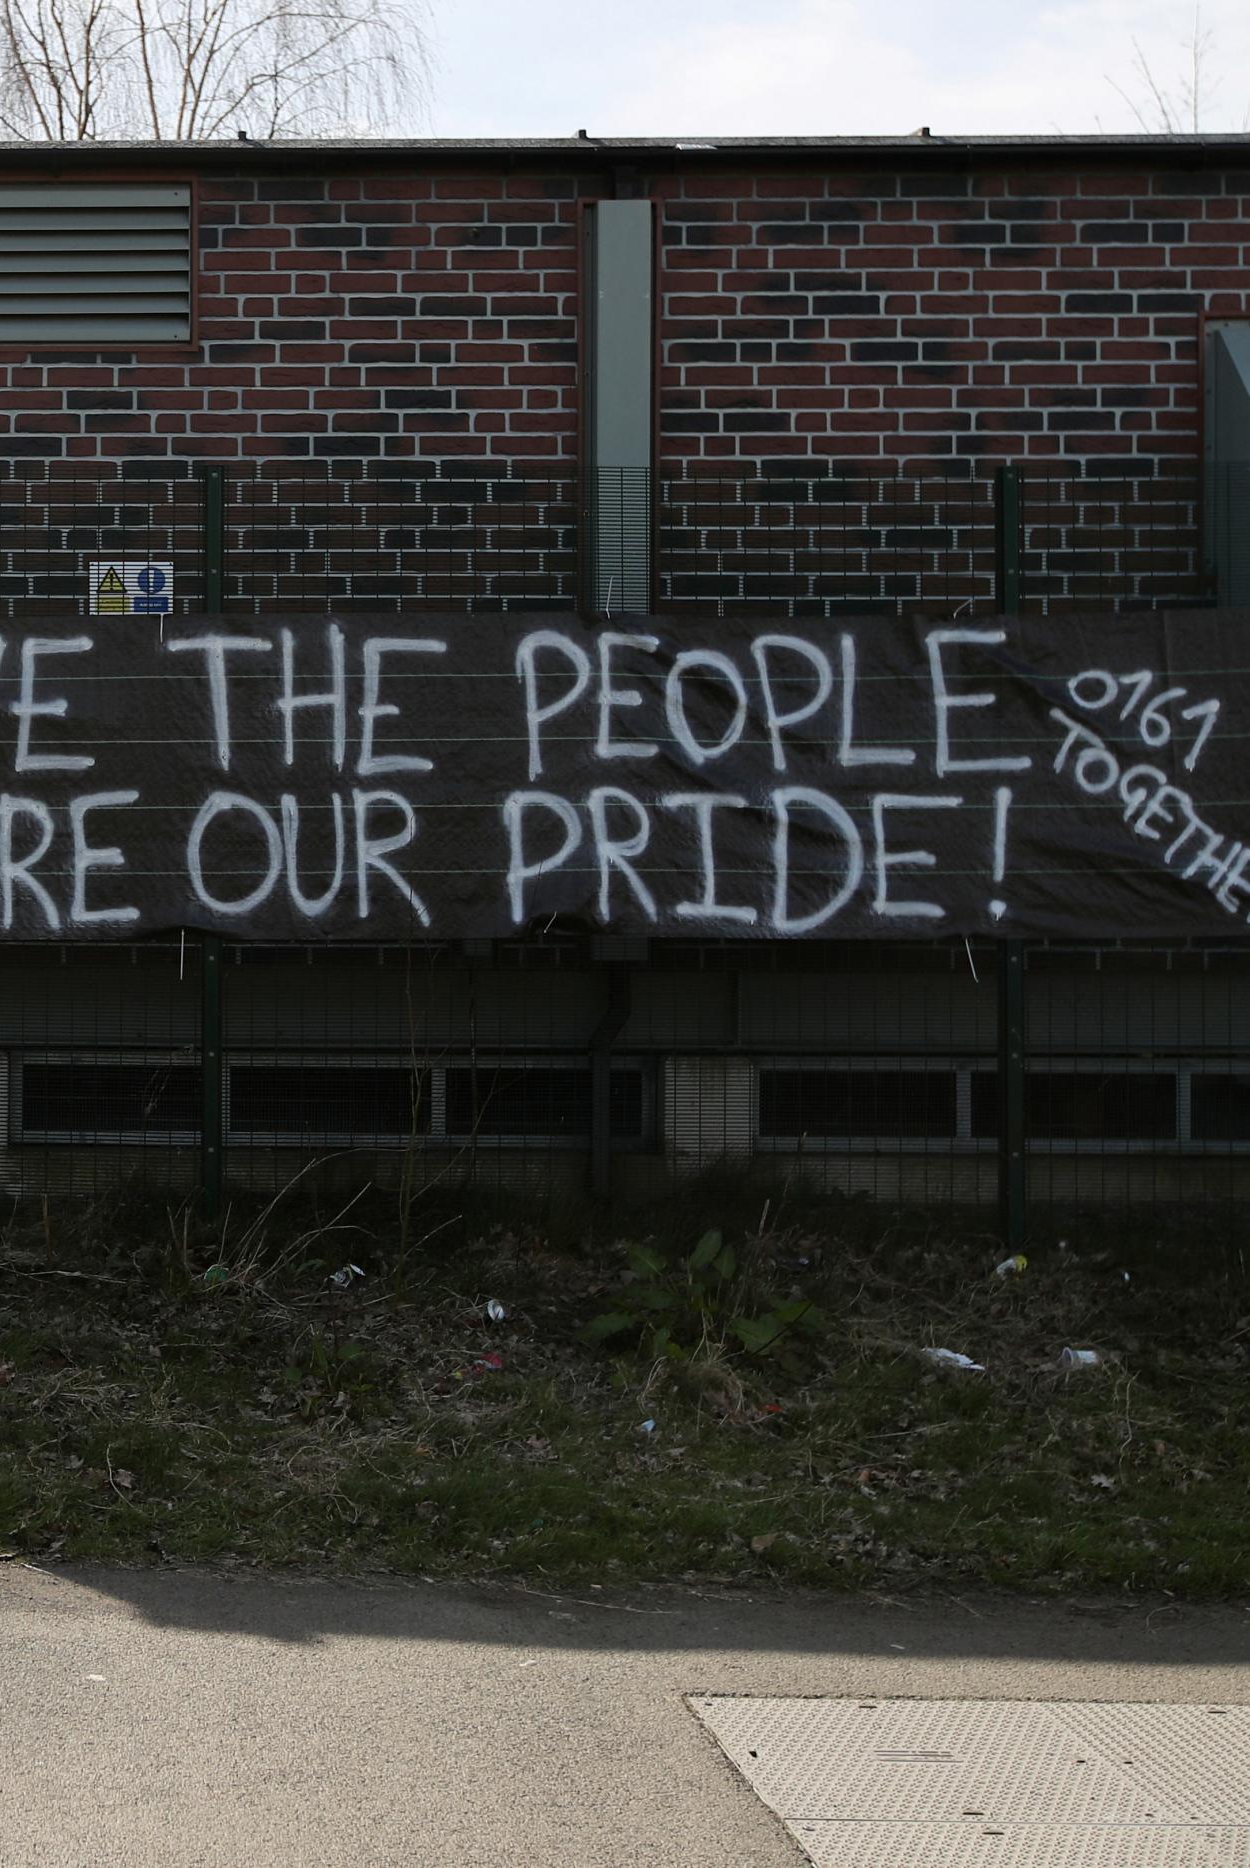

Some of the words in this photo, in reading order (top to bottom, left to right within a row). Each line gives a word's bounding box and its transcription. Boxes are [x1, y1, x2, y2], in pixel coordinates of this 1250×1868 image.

[169, 624, 447, 775] THE
[517, 630, 1031, 780] PEOPLE
[1068, 669, 1220, 771] 0161
[187, 789, 430, 927] OUR
[503, 786, 1007, 934] PRIDE!
[1050, 707, 1250, 924] TOGETHE
